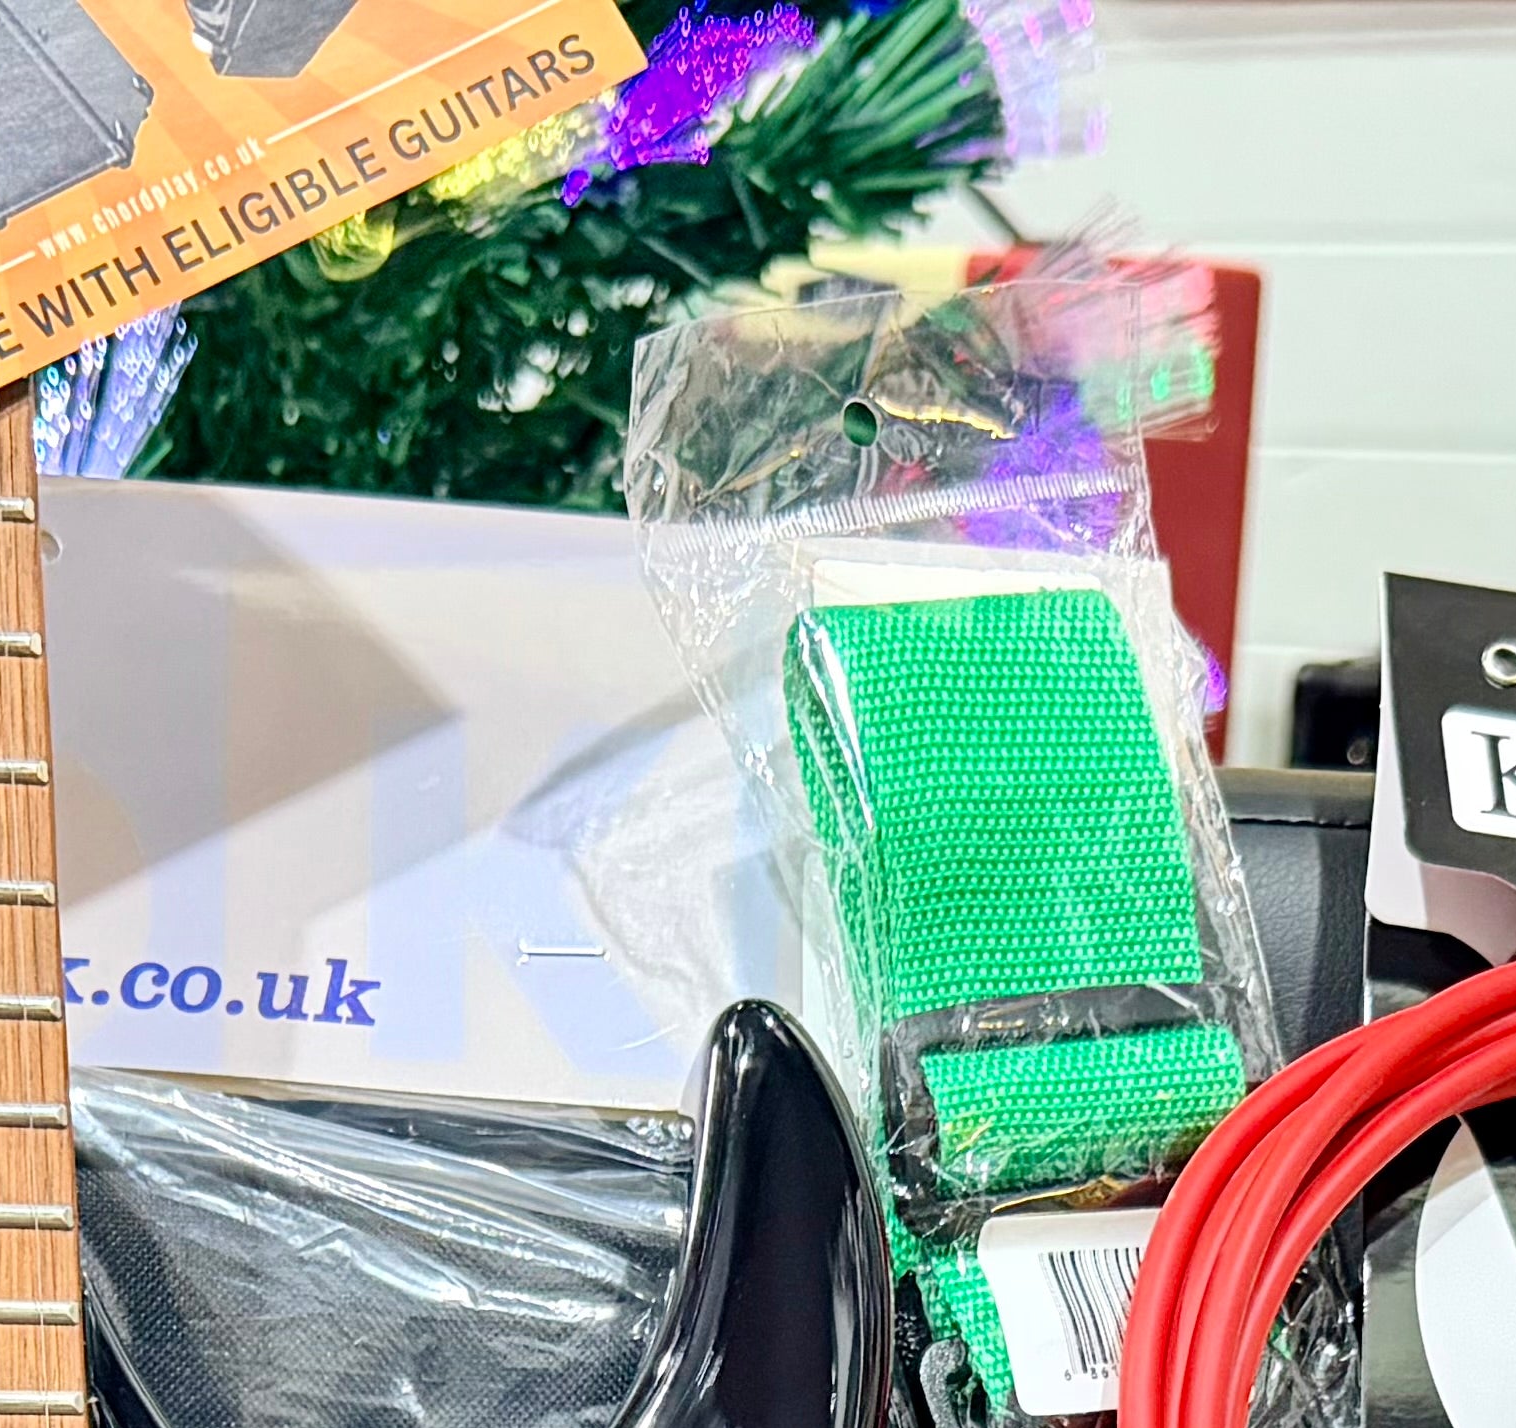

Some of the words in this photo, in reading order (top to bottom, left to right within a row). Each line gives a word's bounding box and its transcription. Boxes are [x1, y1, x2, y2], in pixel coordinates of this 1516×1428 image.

[19, 245, 161, 342] WITH
[161, 137, 386, 273] ELIGIBLE
[386, 33, 596, 161] GUITARS
[37, 135, 268, 260] www.chordplay.co.uk
